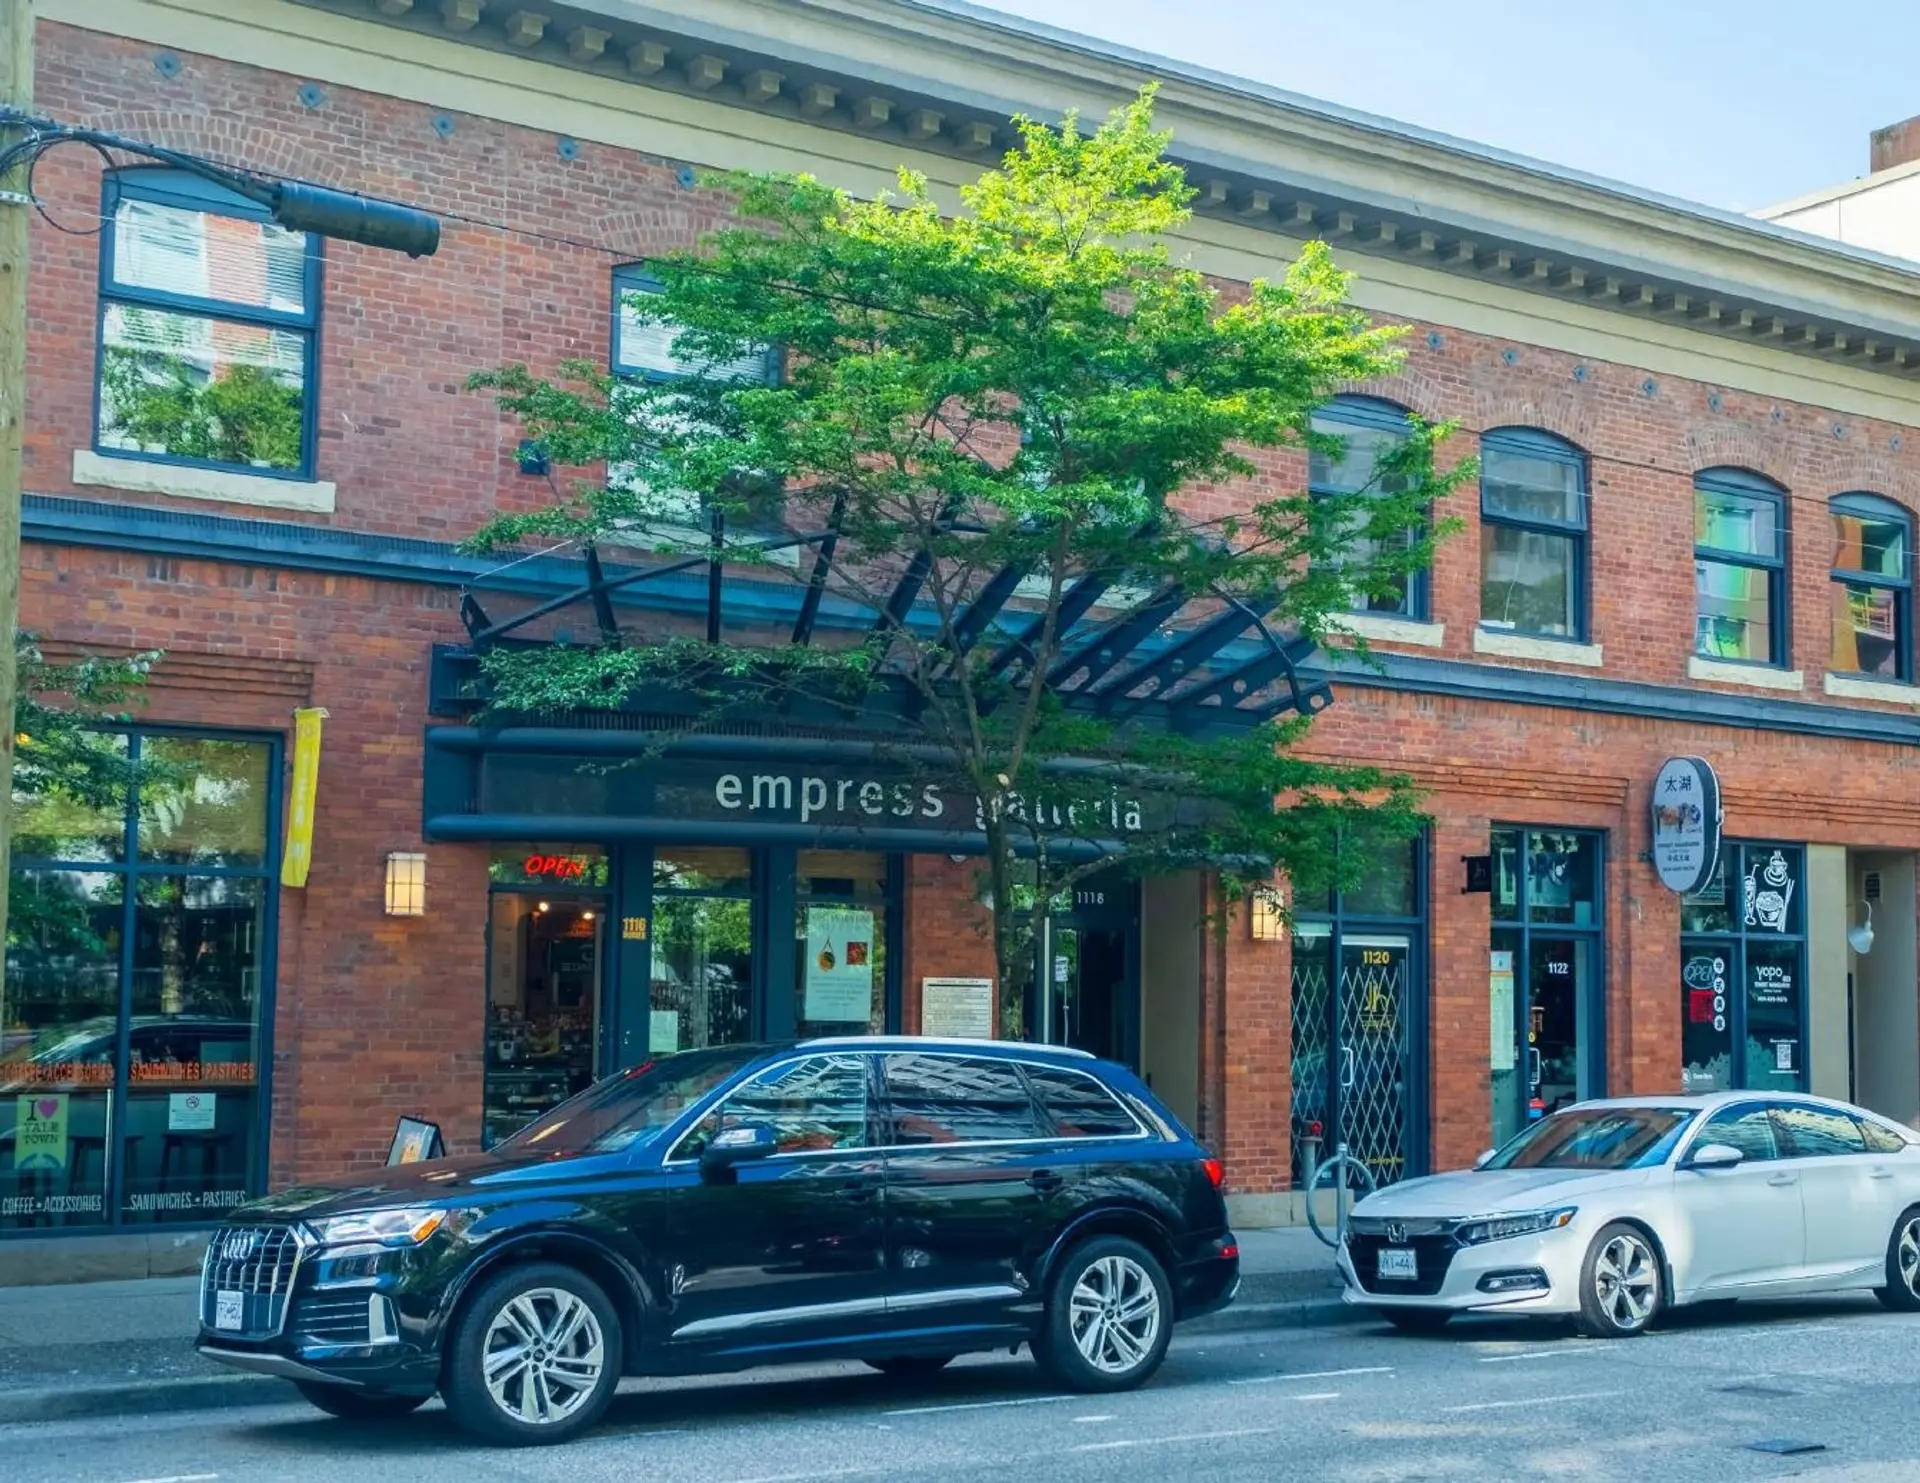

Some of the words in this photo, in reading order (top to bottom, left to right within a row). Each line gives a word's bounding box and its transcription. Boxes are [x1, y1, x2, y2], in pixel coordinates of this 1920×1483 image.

[715, 773, 943, 823] empress
[524, 854, 586, 878] OPEN
[1077, 891, 1104, 905] 1118
[1363, 951, 1390, 964] 1120
[1548, 962, 1568, 974] 1122
[1687, 964, 1715, 982] OPEN
[205, 1062, 255, 1081] PASTRIES
[26, 1099, 38, 1121] I
[2, 1196, 35, 1215] COFFEE
[130, 1191, 192, 1211] SANDWICHES
[202, 1190, 247, 1208] PASTRIES
